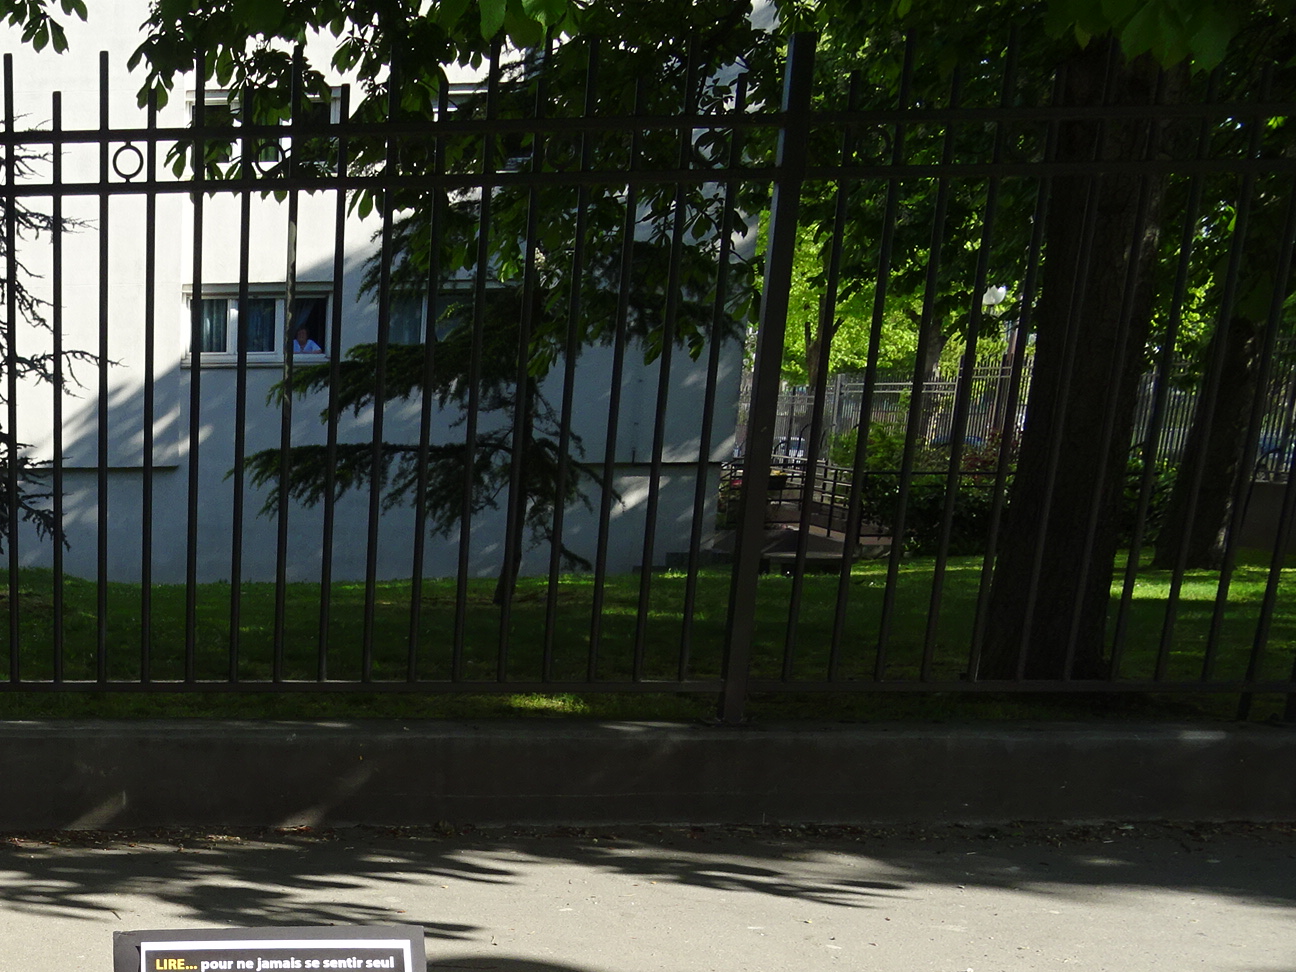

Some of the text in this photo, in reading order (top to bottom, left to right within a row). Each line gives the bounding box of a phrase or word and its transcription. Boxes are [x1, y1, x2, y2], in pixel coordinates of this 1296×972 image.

[155, 956, 395, 972] LIRE... pour ne jamais se sentir seul
